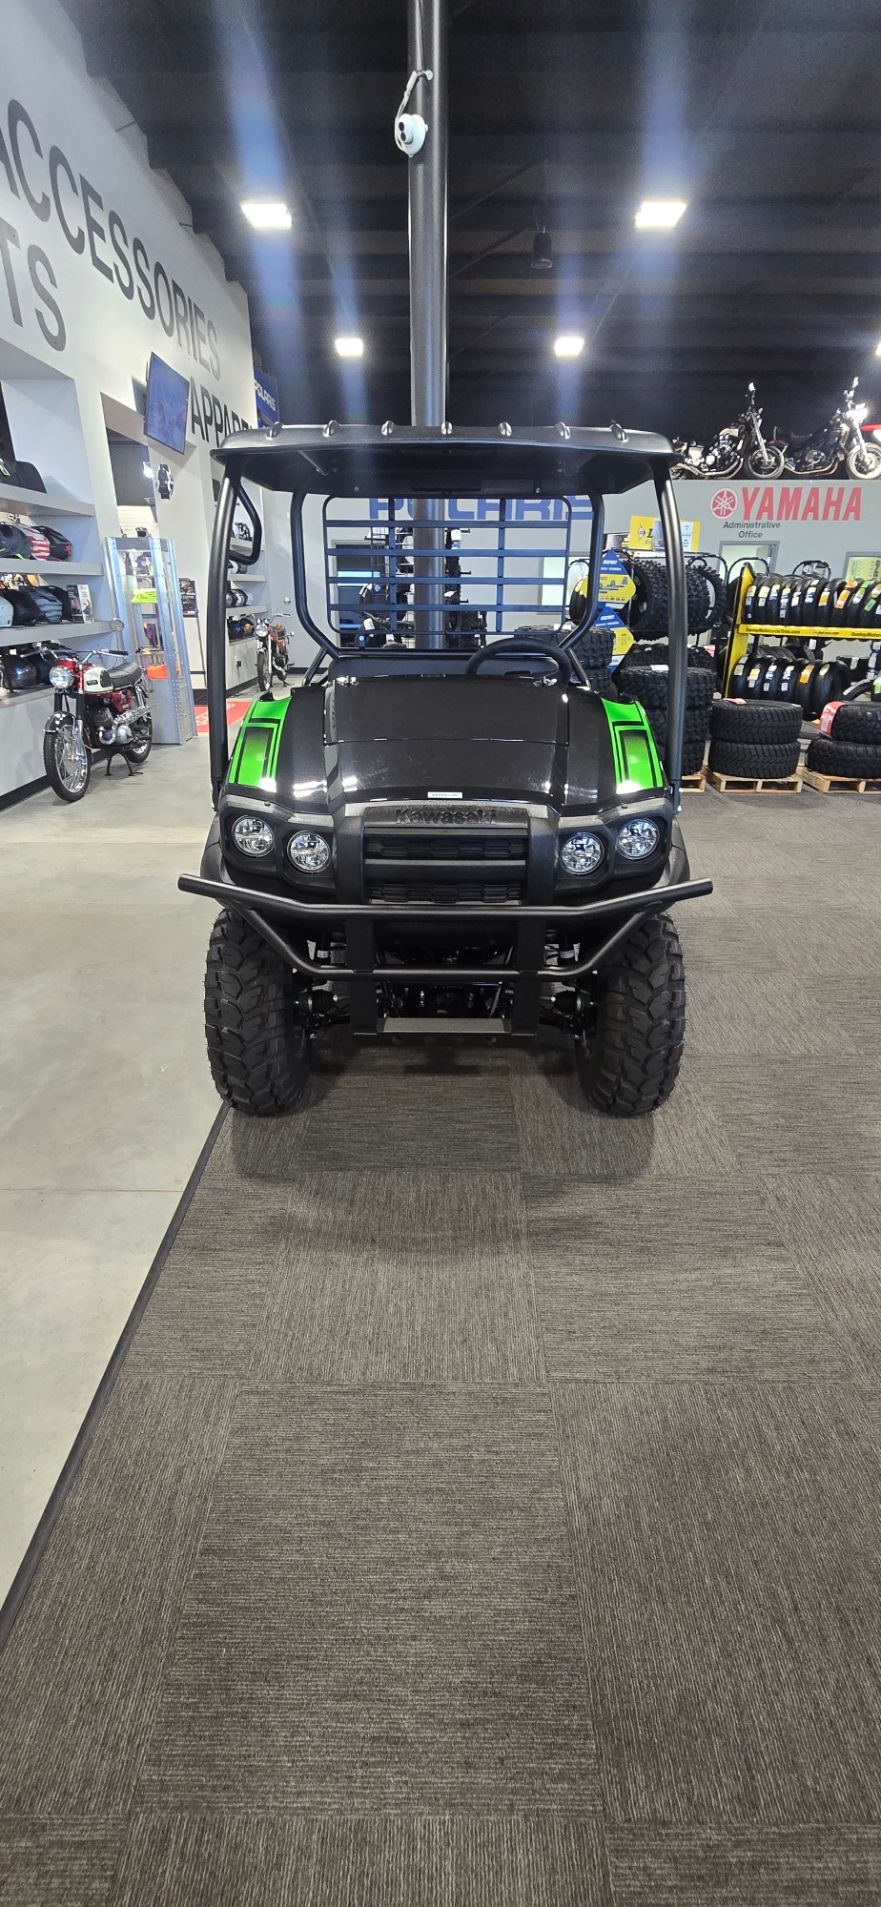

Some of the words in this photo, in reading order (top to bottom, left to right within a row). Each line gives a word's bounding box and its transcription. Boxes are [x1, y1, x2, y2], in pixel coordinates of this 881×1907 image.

[741, 486, 862, 521] YAMAHA
[723, 521, 781, 530] Administrative
[738, 530, 763, 539] Office
[395, 808, 497, 825] Kawasaki
